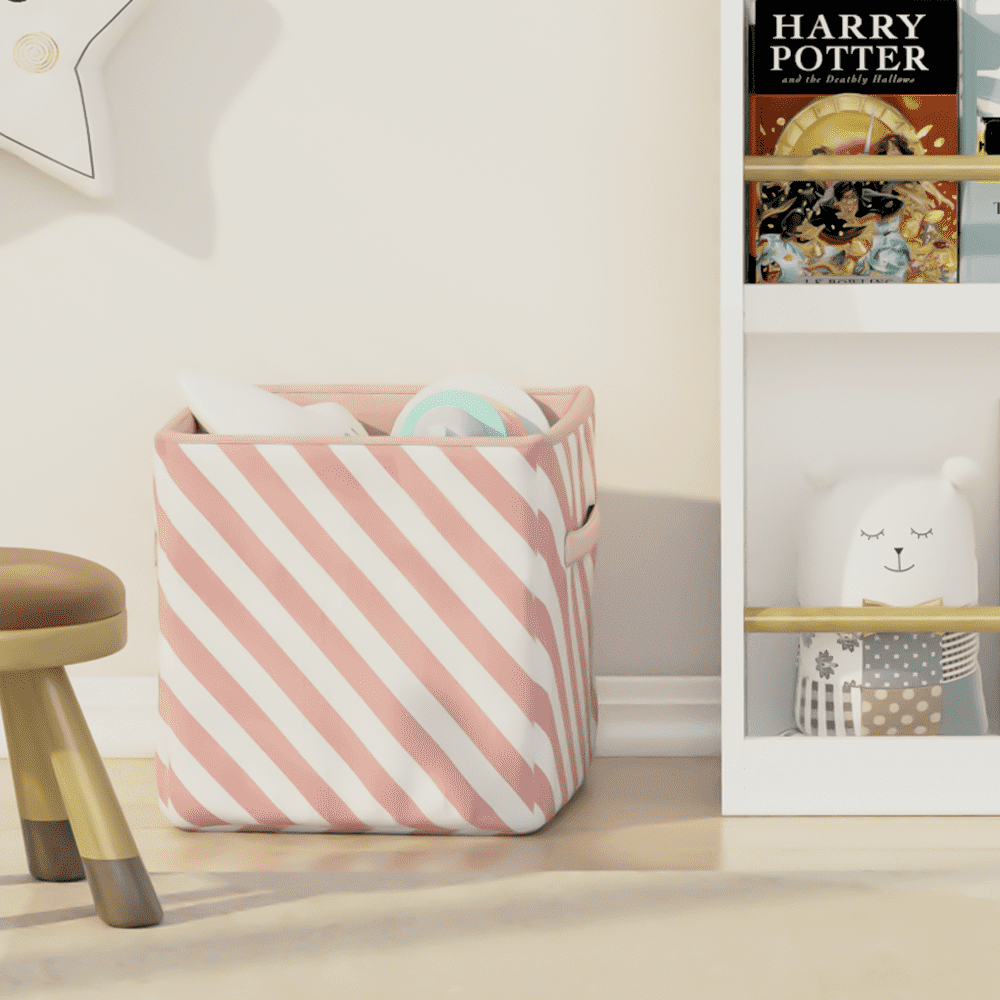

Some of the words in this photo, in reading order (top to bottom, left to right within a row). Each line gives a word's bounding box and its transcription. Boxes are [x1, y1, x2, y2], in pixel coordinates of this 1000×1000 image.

[772, 13, 927, 40] HARRY
[769, 45, 929, 72] POTTER
[781, 74, 802, 83] and
[805, 74, 821, 83] the
[826, 74, 868, 85] Deathly
[872, 74, 915, 83] Hallows
